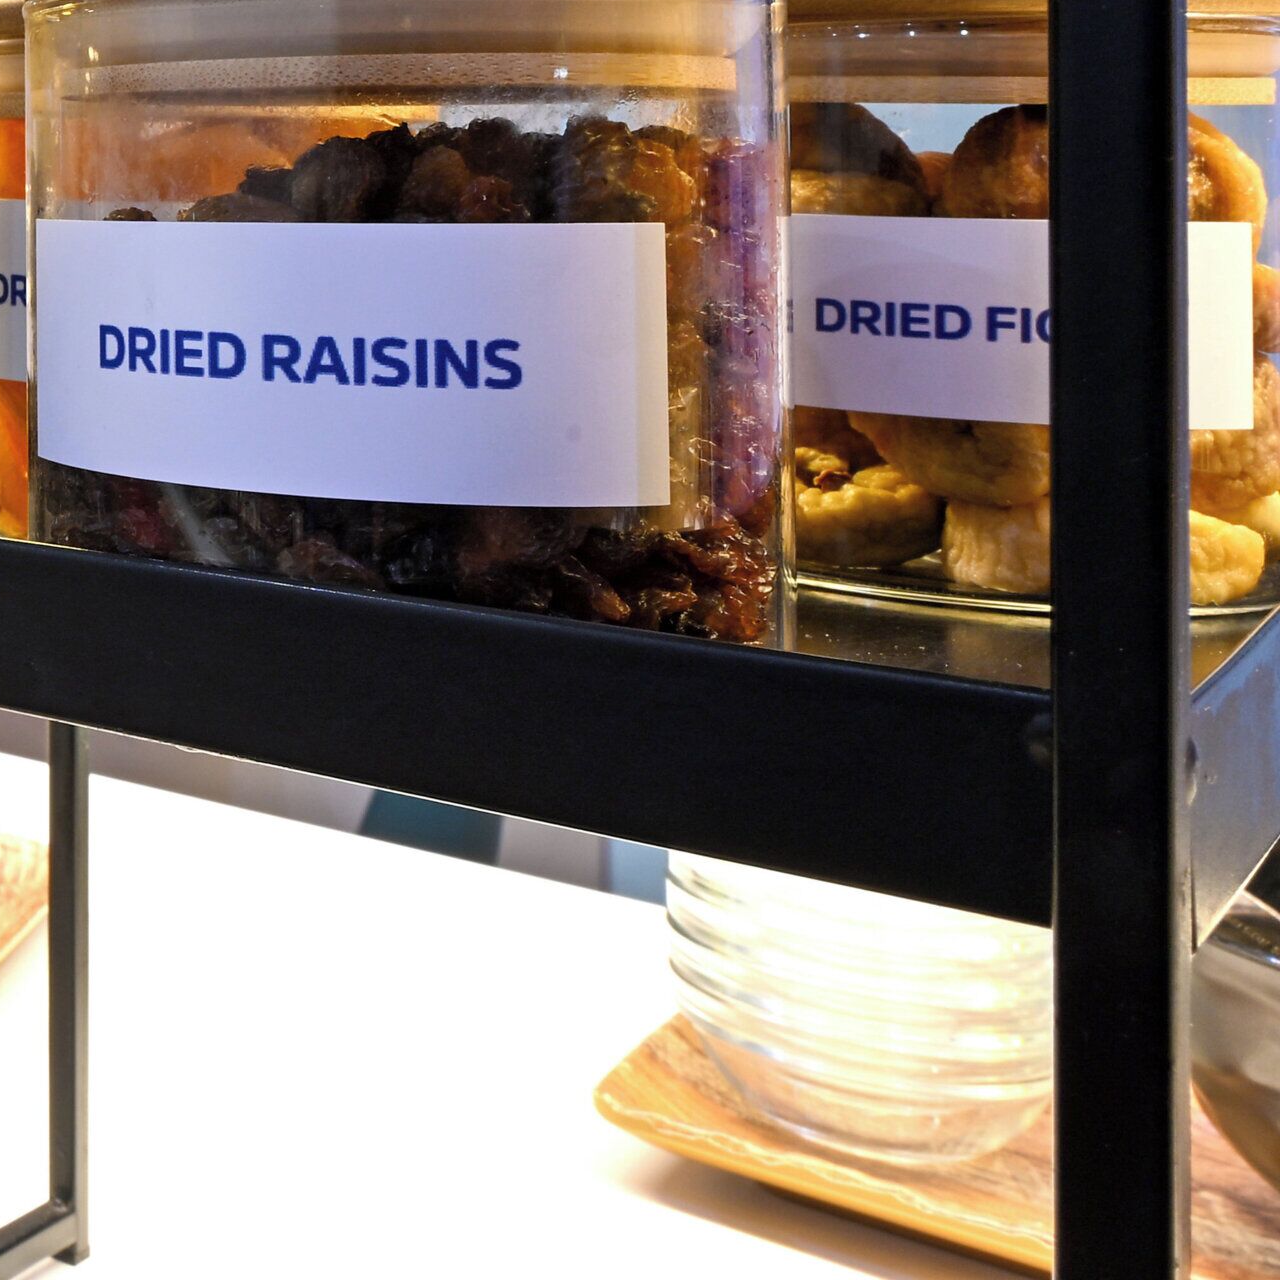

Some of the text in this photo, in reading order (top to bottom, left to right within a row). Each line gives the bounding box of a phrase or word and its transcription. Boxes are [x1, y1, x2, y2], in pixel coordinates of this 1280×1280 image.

[815, 298, 972, 340] DRIED
[99, 324, 523, 388] DRIED RAISINS
